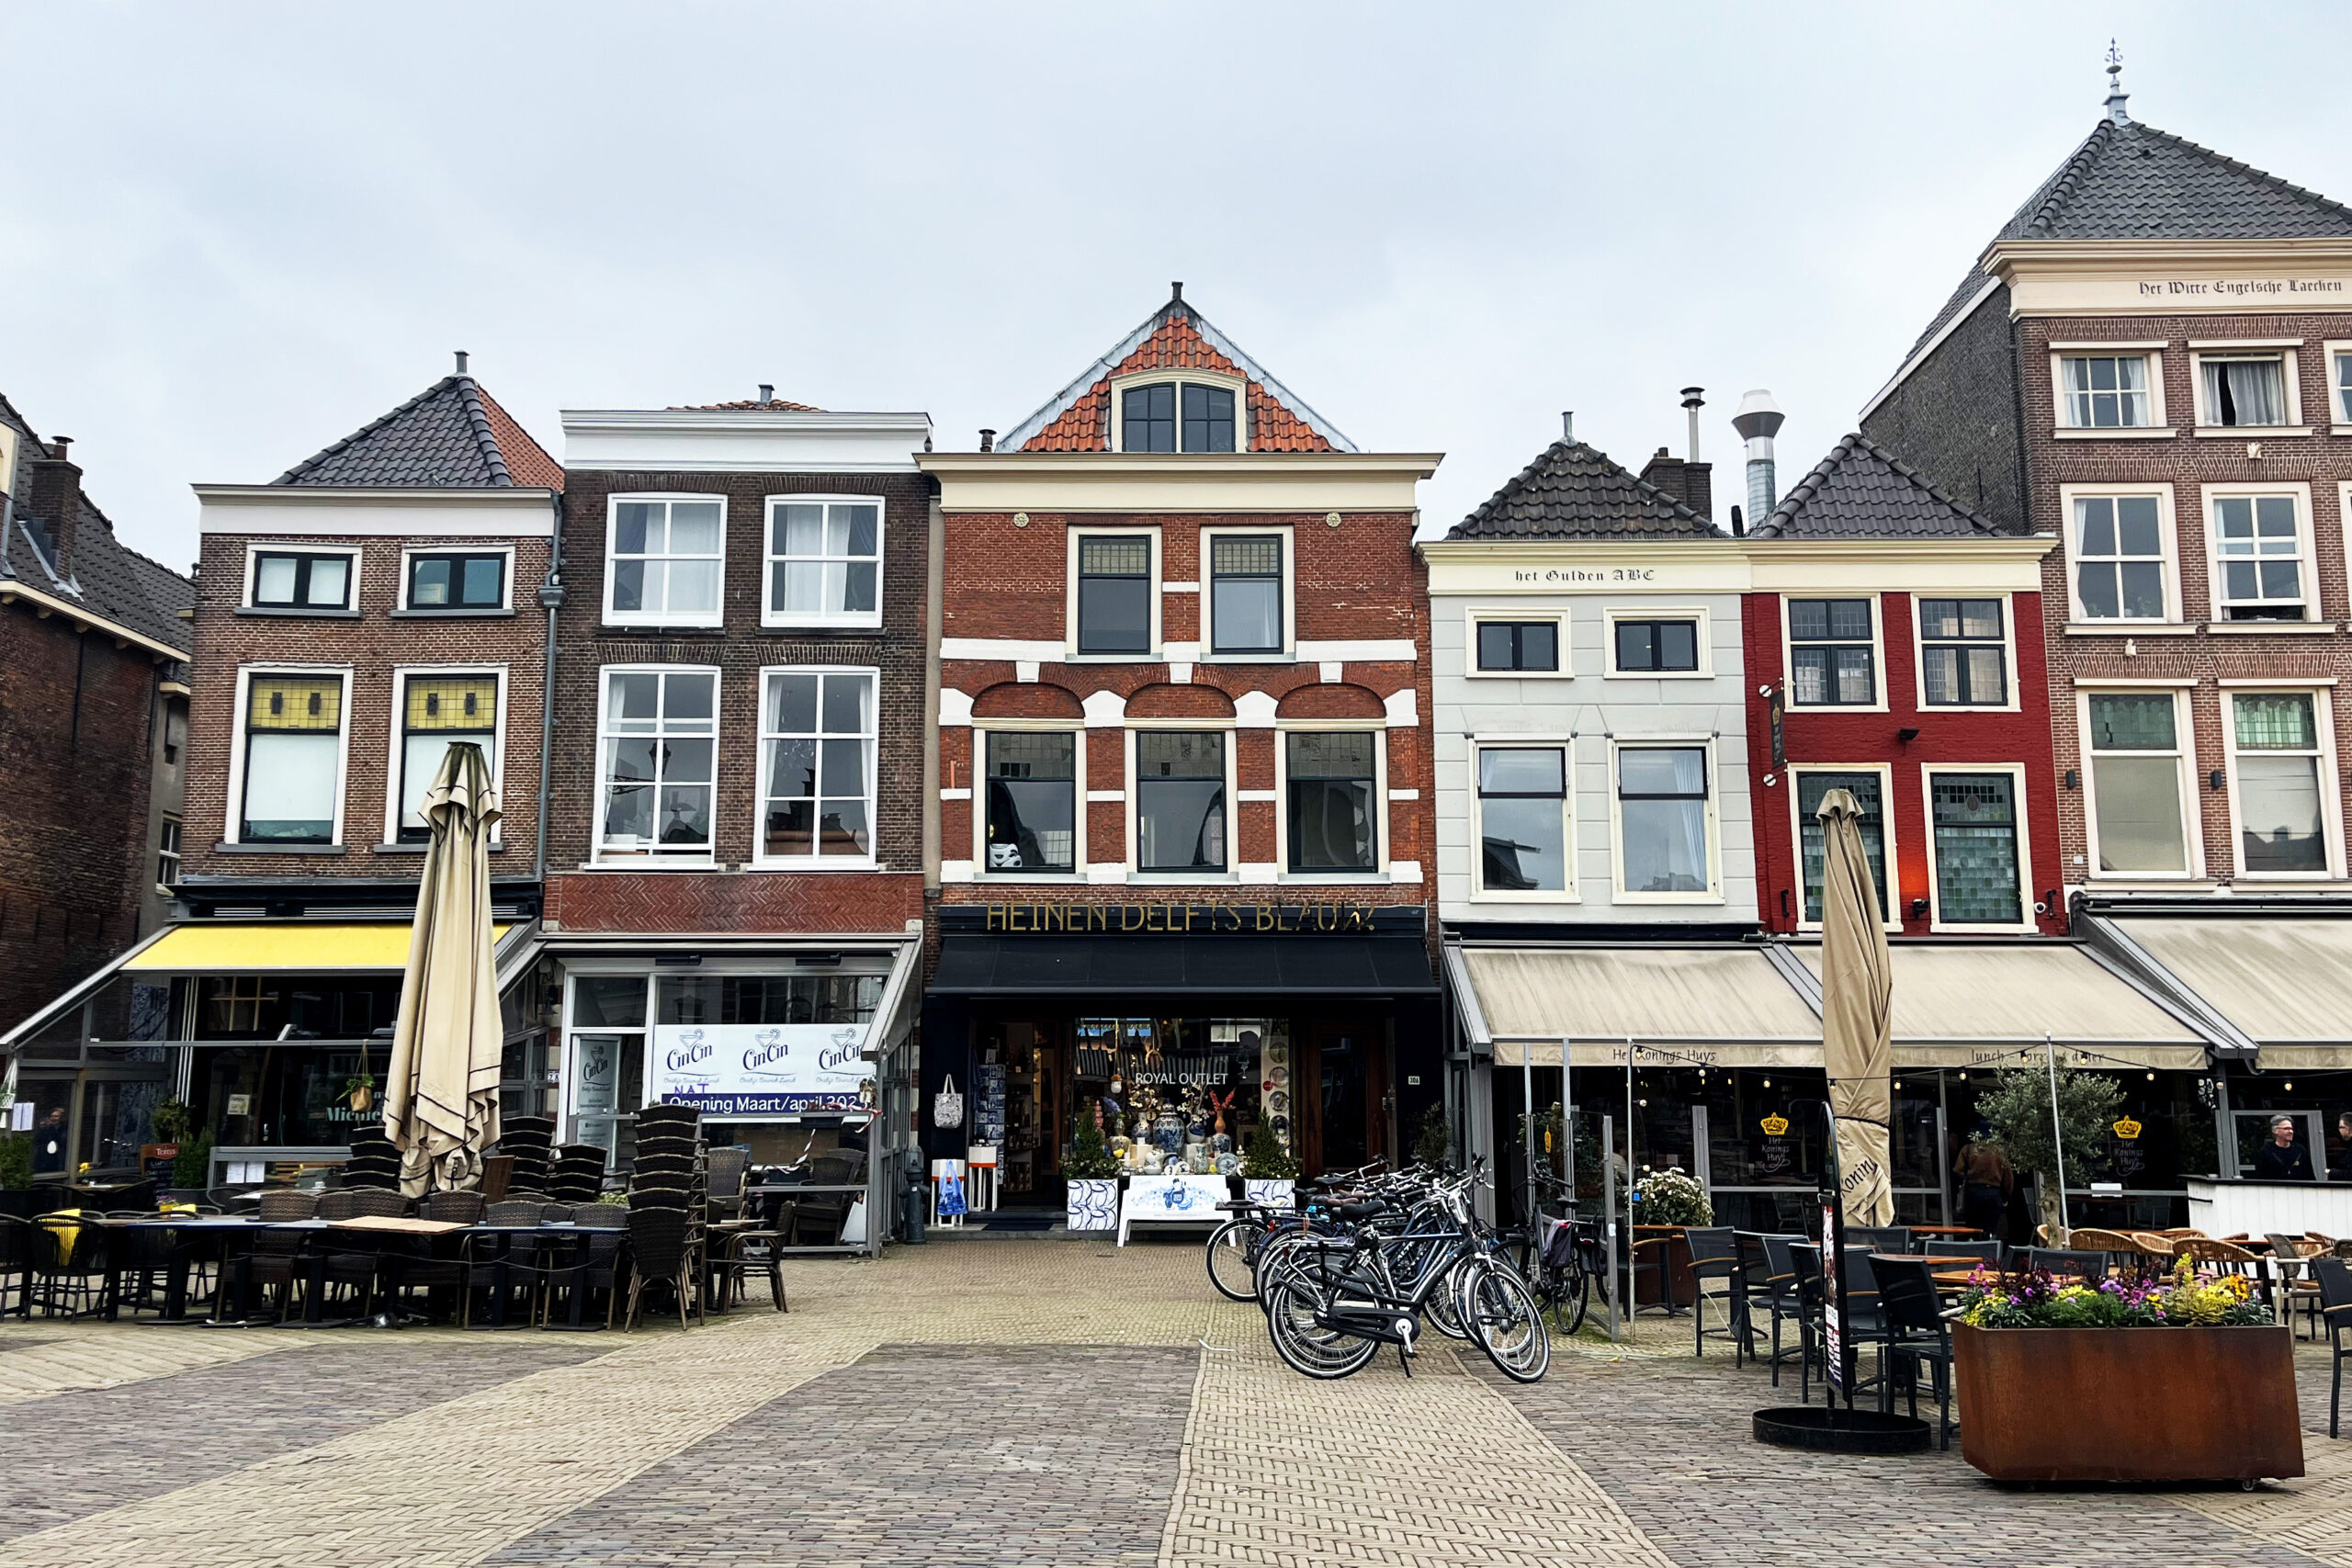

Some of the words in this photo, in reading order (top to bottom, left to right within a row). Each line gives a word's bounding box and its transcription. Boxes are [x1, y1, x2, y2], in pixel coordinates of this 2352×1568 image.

[2168, 281, 2207, 294] Witte
[1516, 570, 1537, 581] het
[1545, 570, 1604, 581] Gulden
[1612, 570, 1655, 581] ABC
[987, 901, 1106, 931] HEINEN
[1122, 901, 1240, 931] DELFTS
[1612, 1049, 1628, 1060] He
[1687, 1049, 1716, 1062] Huys
[1972, 1049, 2004, 1062] lunch
[1136, 1073, 1175, 1085] ROYAL
[1180, 1073, 1228, 1085] OUTLET
